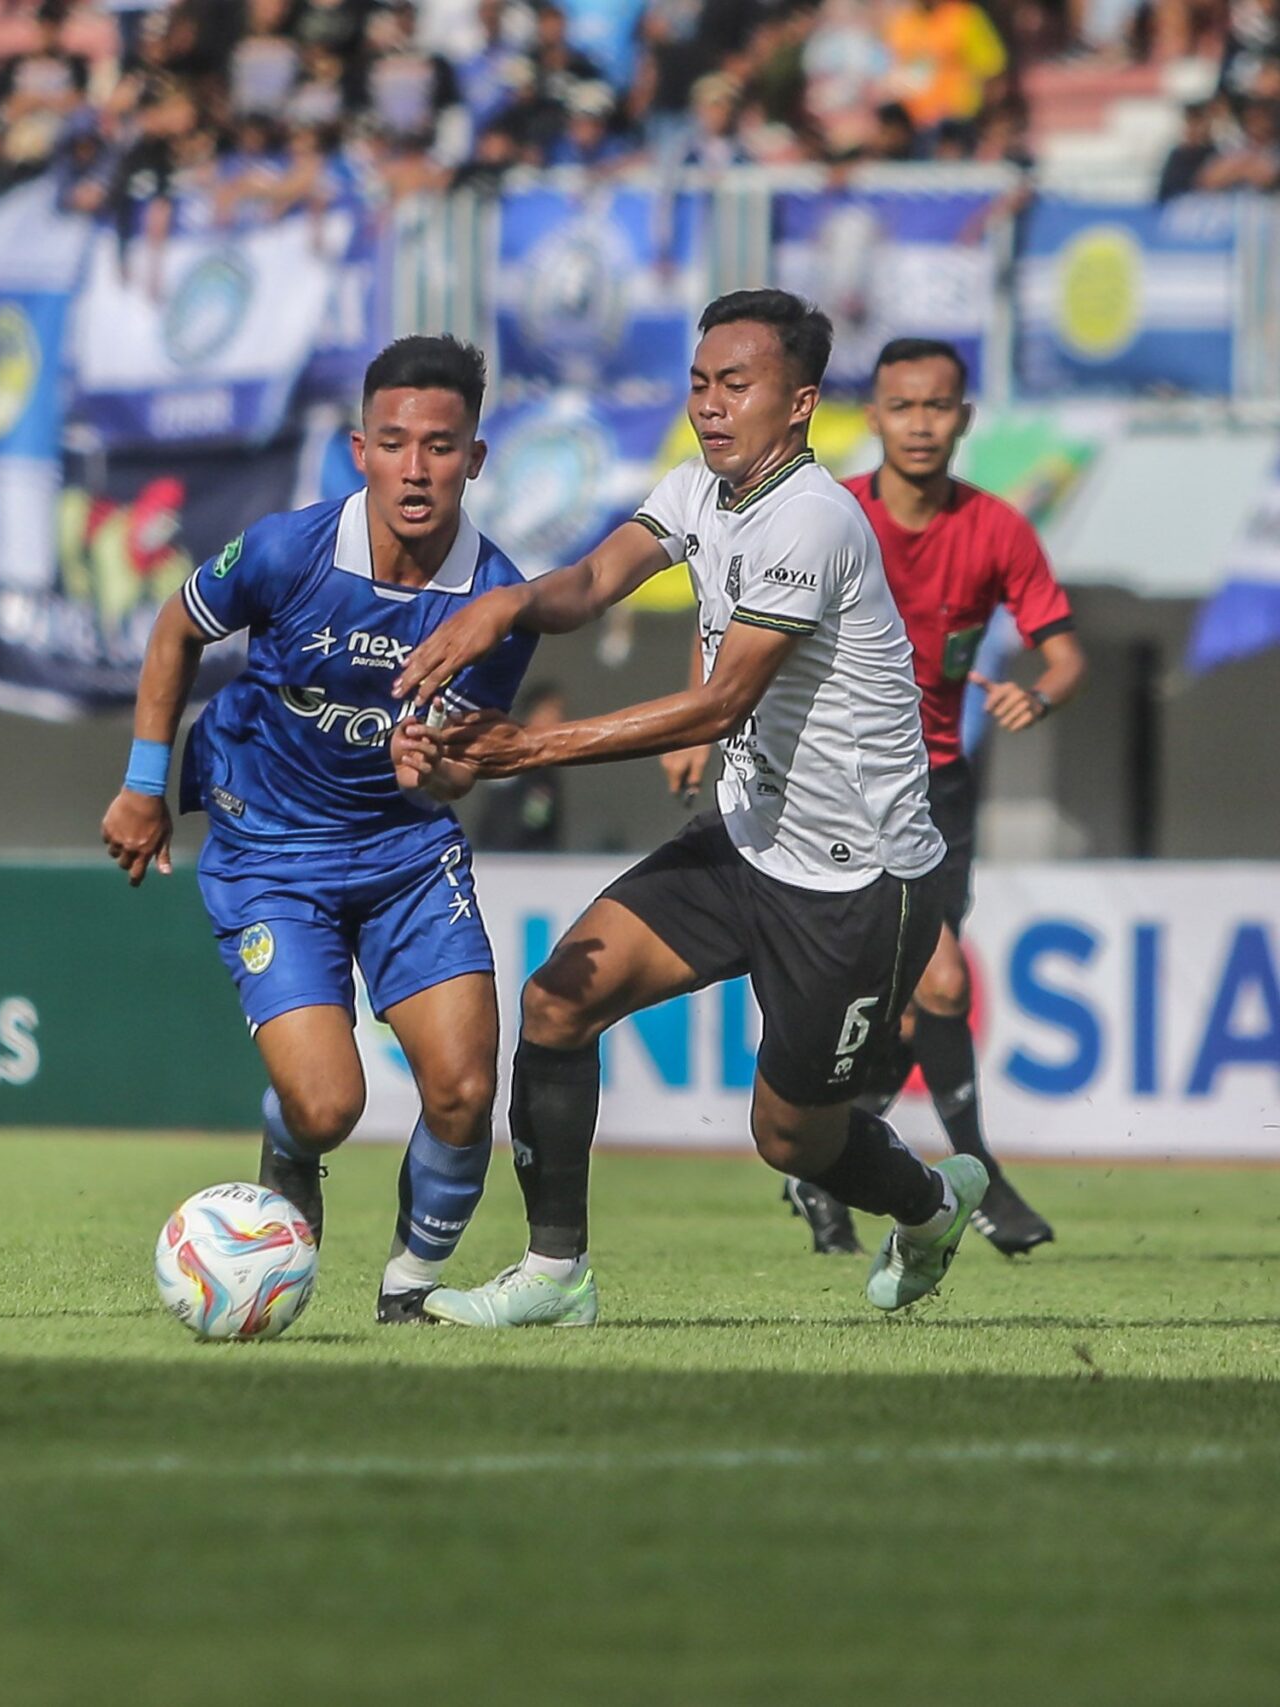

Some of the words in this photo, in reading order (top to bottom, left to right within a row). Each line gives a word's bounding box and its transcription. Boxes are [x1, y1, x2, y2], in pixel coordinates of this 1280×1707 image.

[763, 567, 818, 587] ROYAL
[348, 631, 413, 663] nex
[351, 656, 395, 670] parabola
[279, 686, 416, 747] Gra
[835, 996, 879, 1056] 6
[200, 1186, 258, 1204] SPECS
